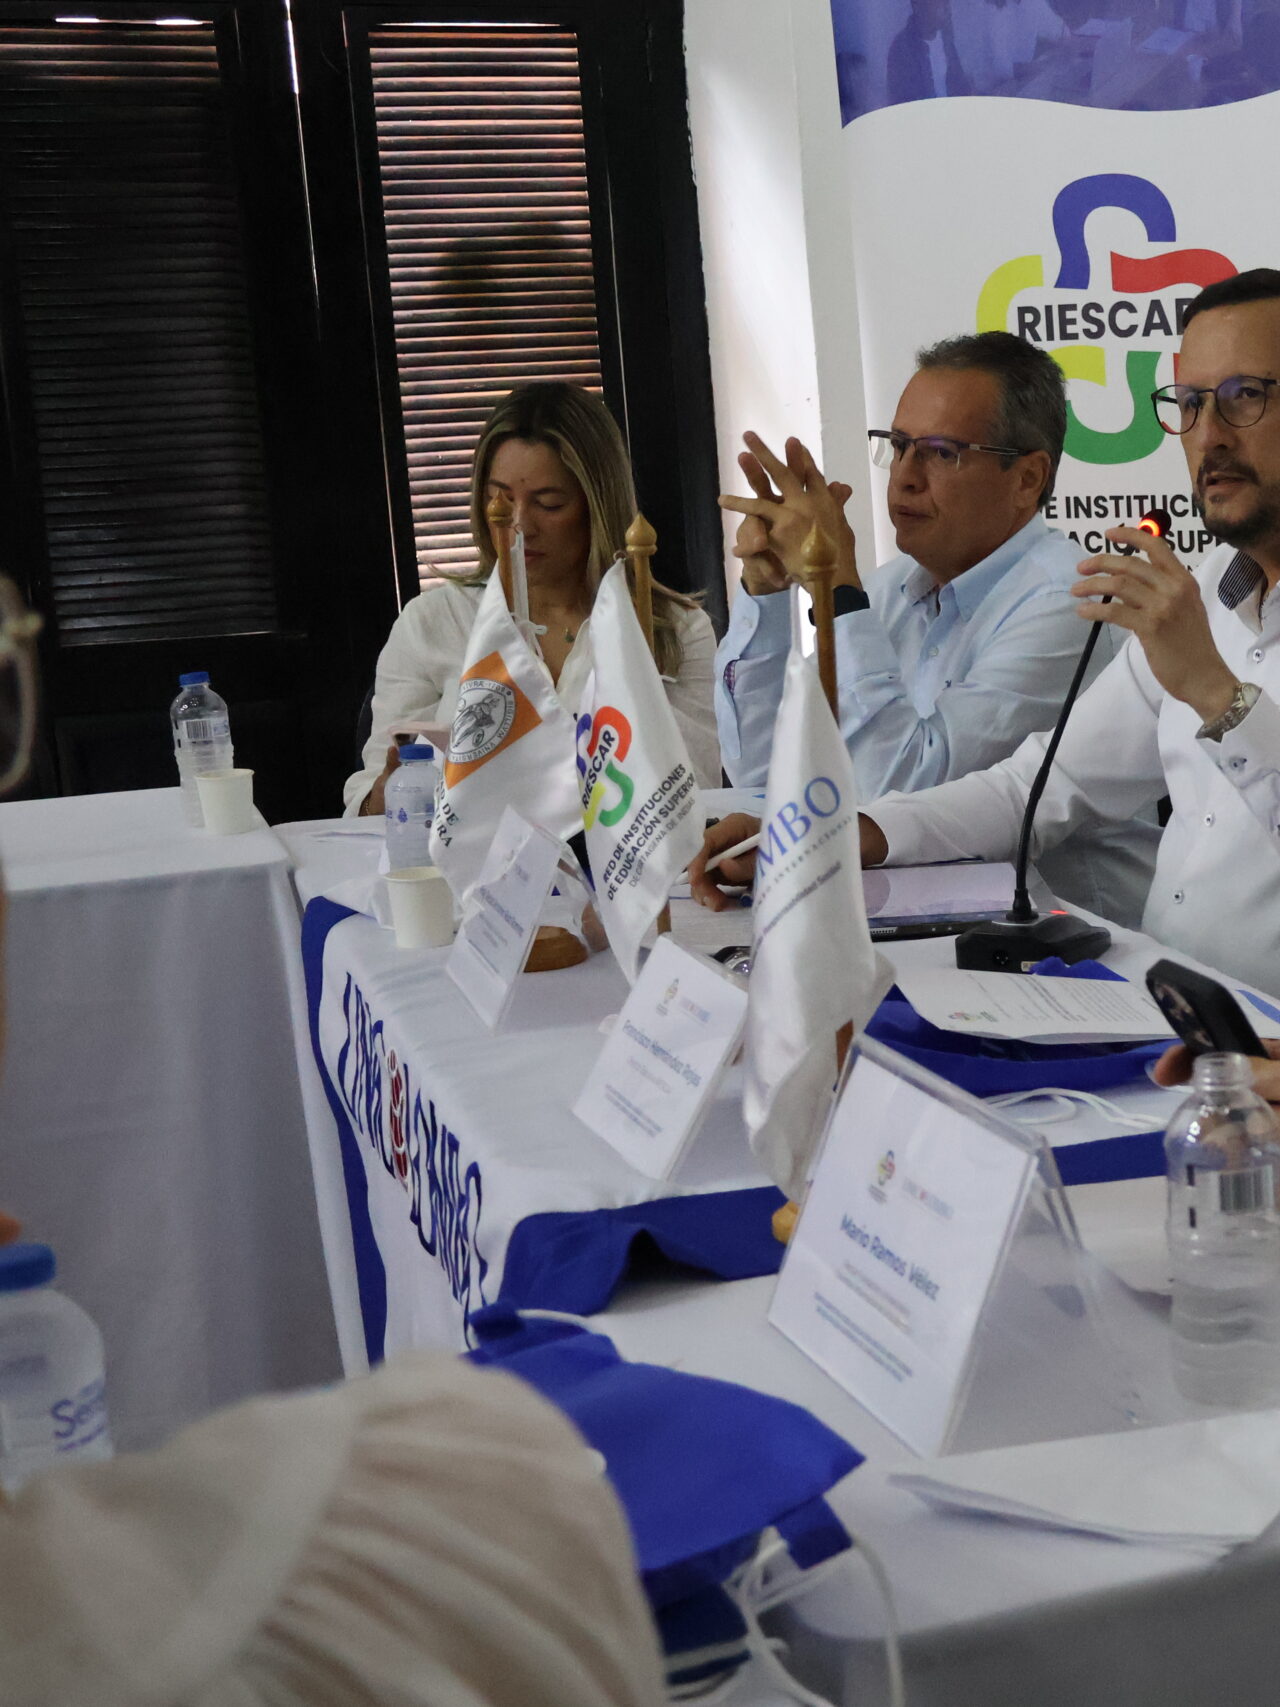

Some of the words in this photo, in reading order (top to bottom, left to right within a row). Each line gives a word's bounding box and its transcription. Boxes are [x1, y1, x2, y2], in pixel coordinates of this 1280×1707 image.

[1164, 530, 1221, 553] SUP
[582, 729, 615, 810] RIESCAR
[442, 803, 459, 826] DE
[603, 861, 617, 883] RED
[613, 845, 626, 862] DE
[622, 763, 686, 846] INSTITUCIONES
[607, 884, 618, 901] DE
[615, 816, 661, 885] EDUCACIÓN
[840, 1213, 870, 1249] Mario
[869, 1235, 908, 1278] Ramos
